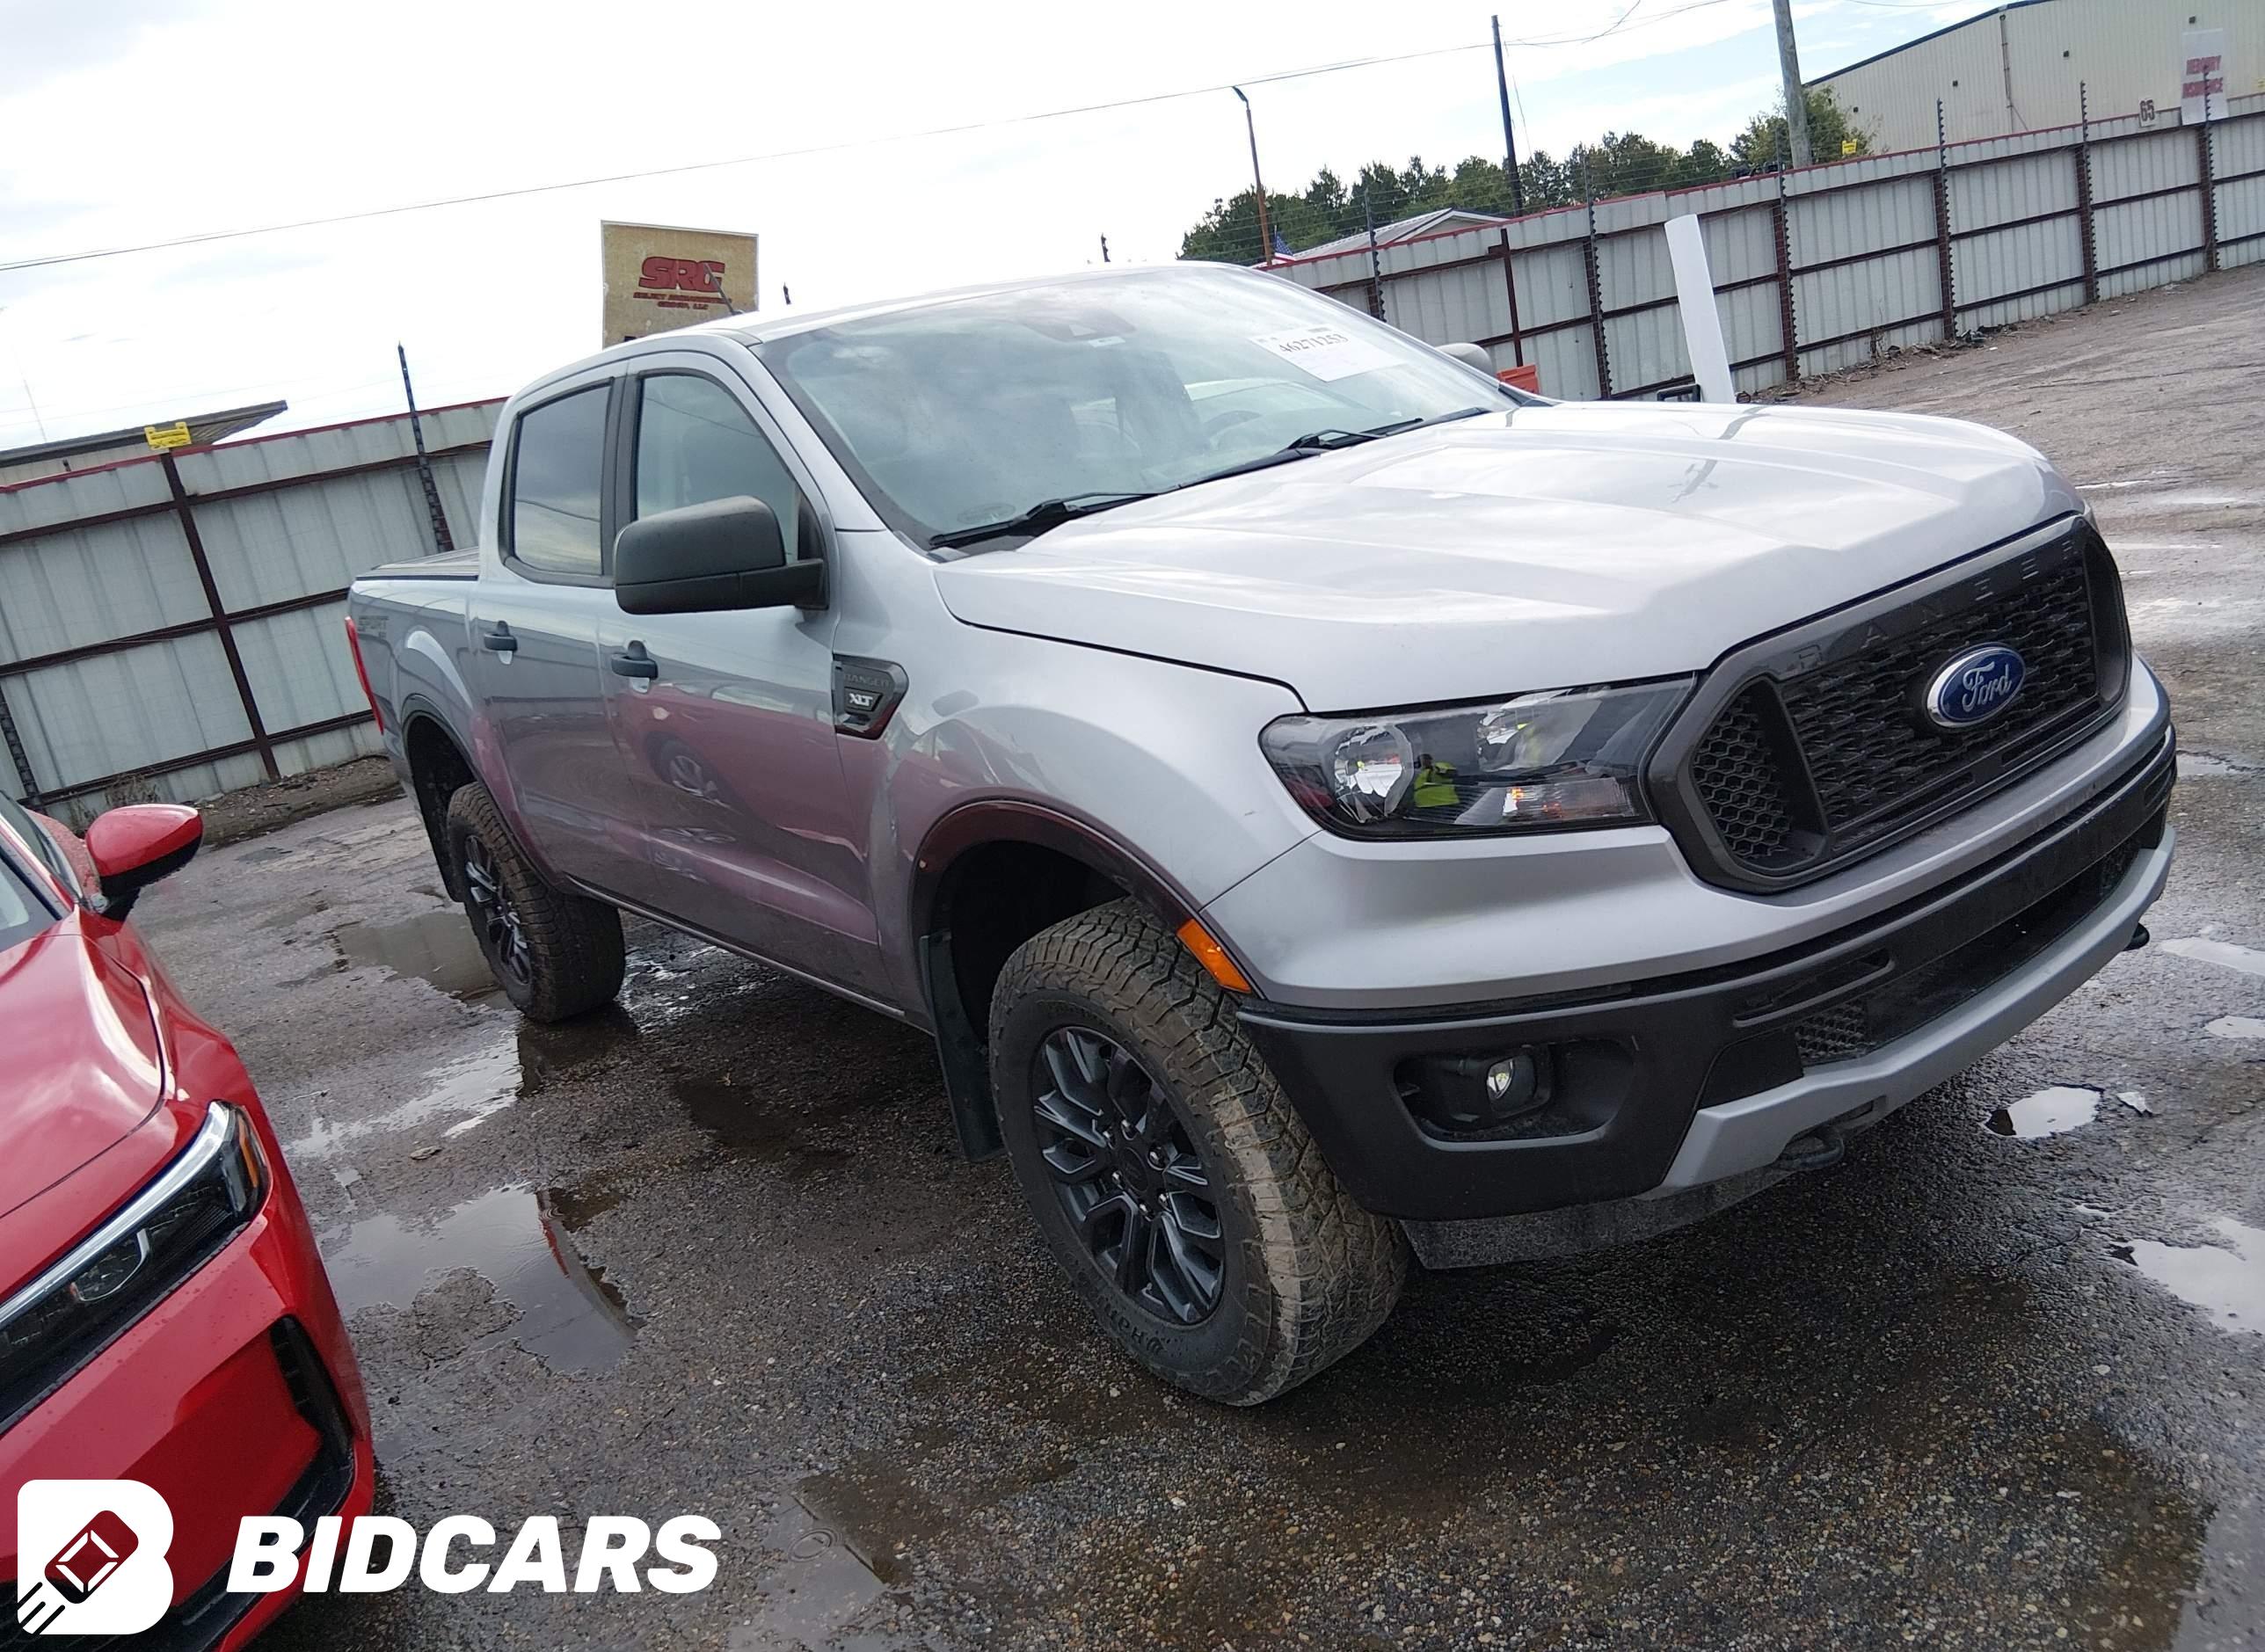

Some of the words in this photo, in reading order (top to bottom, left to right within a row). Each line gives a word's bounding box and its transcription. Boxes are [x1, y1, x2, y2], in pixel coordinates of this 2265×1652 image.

[2139, 99, 2155, 121] 65
[1278, 333, 1349, 353] 46271253
[1962, 661, 2012, 712] Ford
[848, 693, 873, 707] XLT
